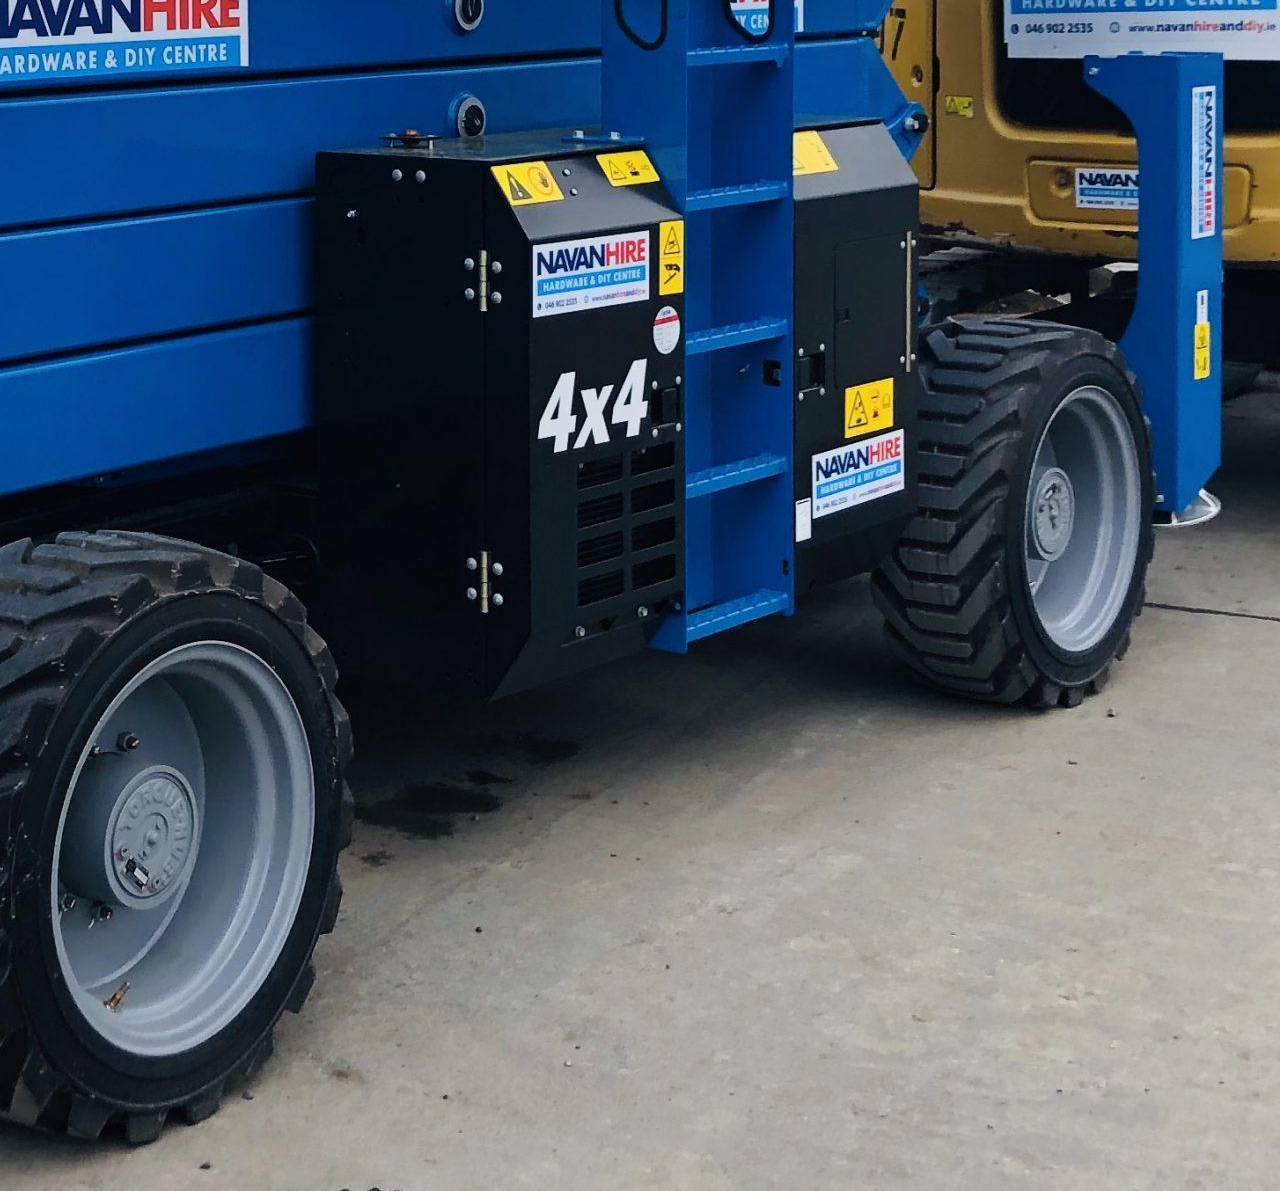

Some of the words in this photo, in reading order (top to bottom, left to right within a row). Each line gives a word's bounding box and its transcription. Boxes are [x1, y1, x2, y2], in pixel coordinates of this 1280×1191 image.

[1025, 22, 1045, 34] 046
[1046, 22, 1066, 33] 902
[1067, 22, 1093, 33] 2535
[1128, 20, 1277, 35] www.navanhireanddiy.ie
[104, 50, 118, 69] &
[125, 46, 156, 67] DIY
[162, 42, 228, 65] CENTRE
[537, 238, 646, 276] NAVANHIRE
[542, 278, 588, 293] HARDWARE
[589, 276, 596, 285] &
[598, 273, 611, 284] DIY
[613, 268, 641, 282] CENTRE
[537, 358, 648, 453] 4x4
[815, 435, 901, 482] NAVANHIRE
